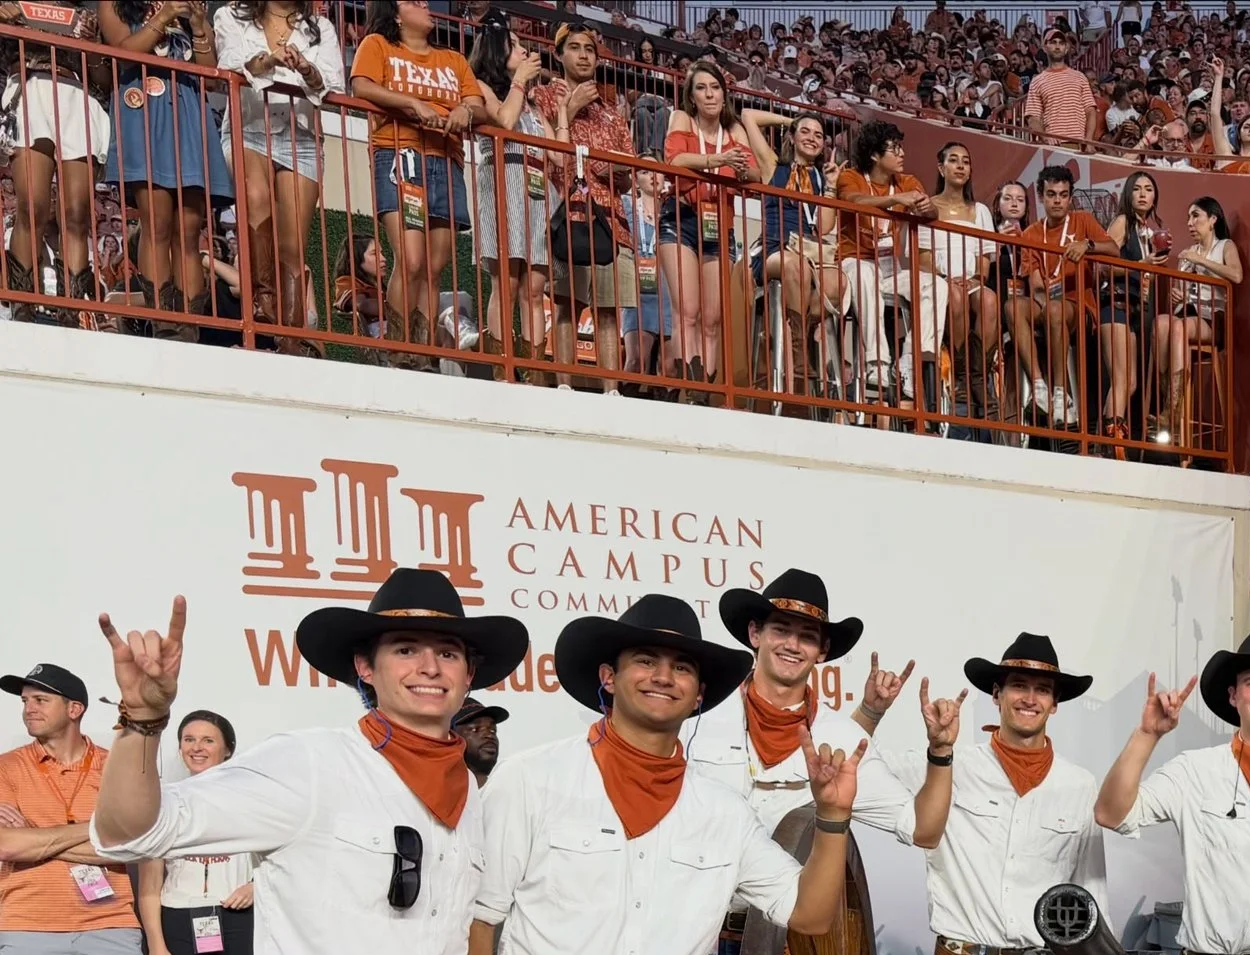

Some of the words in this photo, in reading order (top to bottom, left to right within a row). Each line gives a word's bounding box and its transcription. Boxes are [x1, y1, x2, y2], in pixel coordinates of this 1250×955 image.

[30, 6, 65, 20] TEXAS
[388, 56, 459, 93] TEXAS
[505, 496, 764, 549] AMERICAN
[507, 542, 765, 591] CAMPUS
